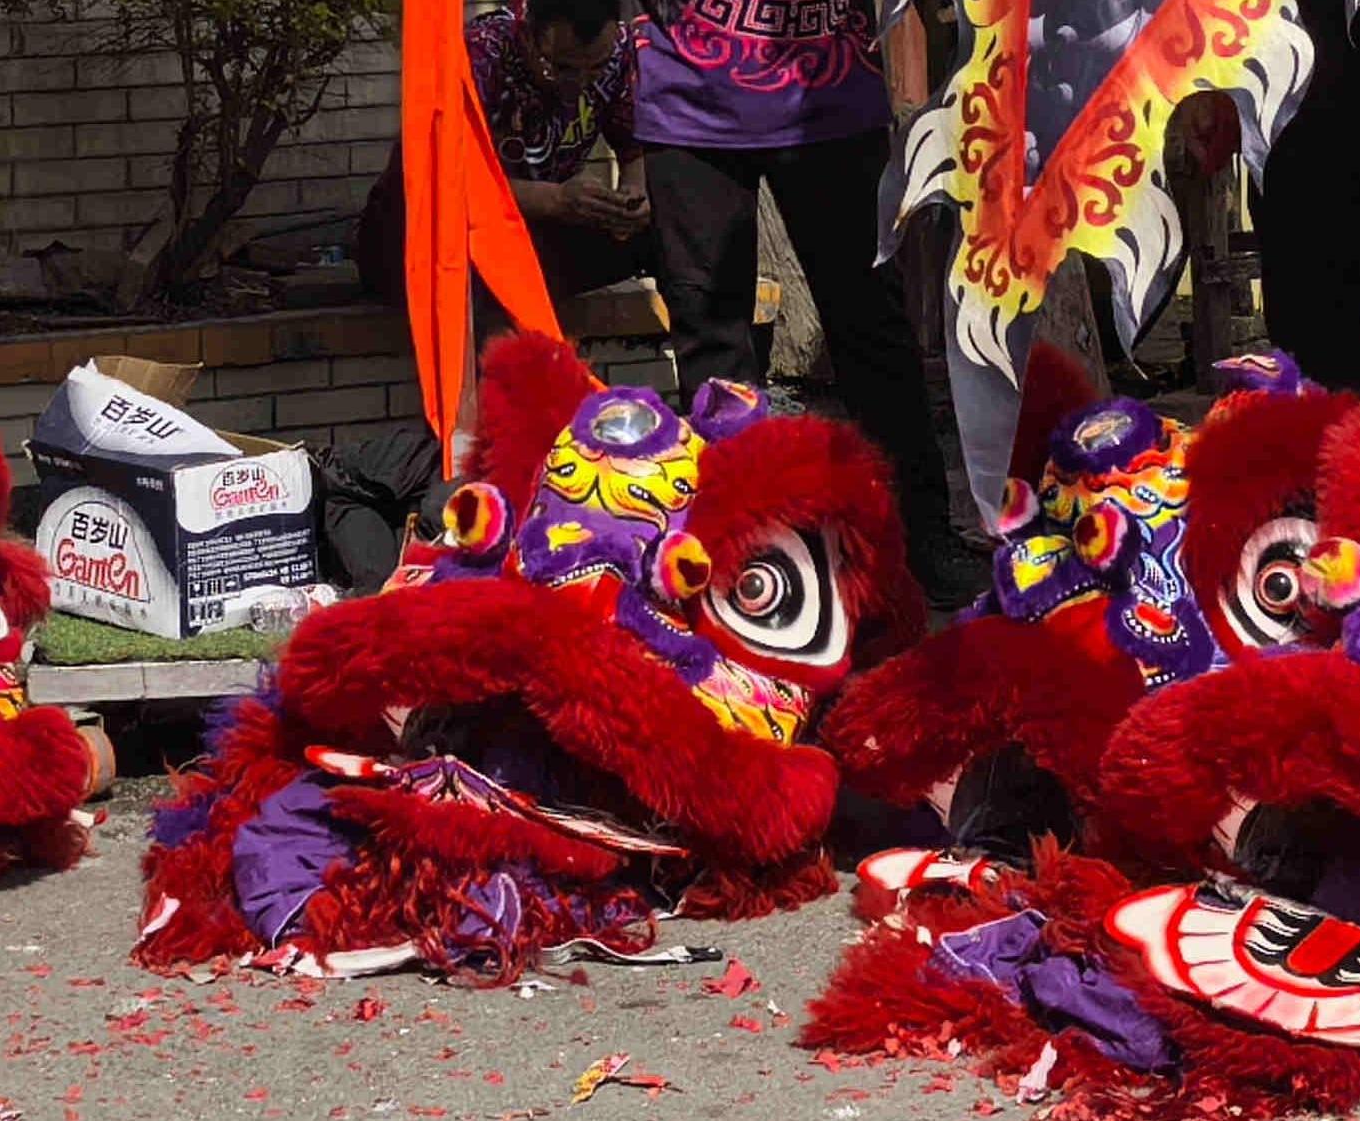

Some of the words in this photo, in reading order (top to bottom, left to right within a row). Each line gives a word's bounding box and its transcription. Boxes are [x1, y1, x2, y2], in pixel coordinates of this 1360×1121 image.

[101, 394, 180, 440] 百岁山
[222, 469, 266, 486] 百岁山
[70, 510, 129, 551] 百岁山
